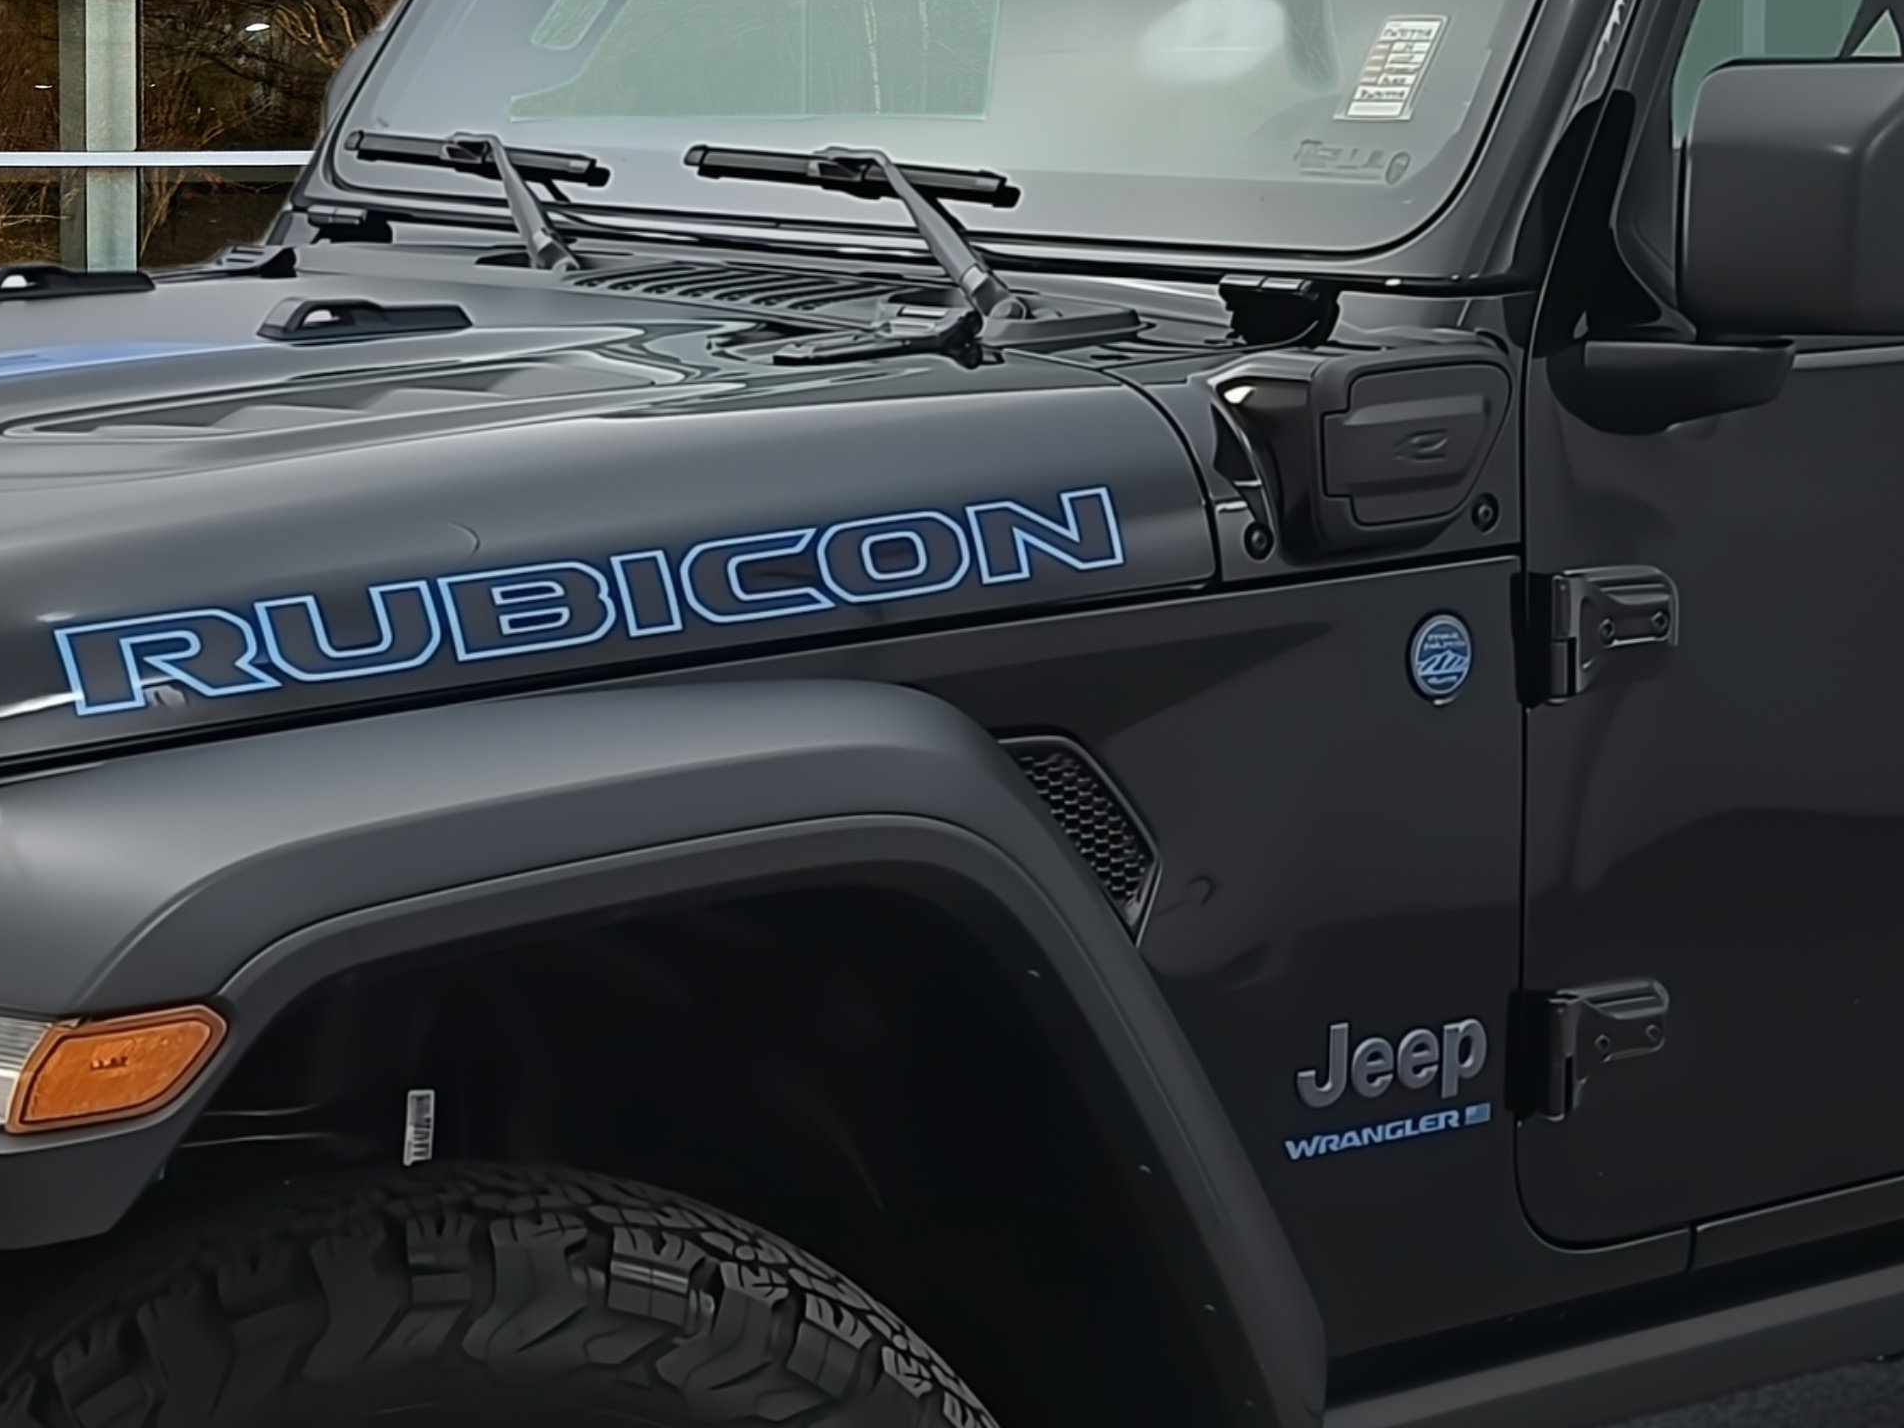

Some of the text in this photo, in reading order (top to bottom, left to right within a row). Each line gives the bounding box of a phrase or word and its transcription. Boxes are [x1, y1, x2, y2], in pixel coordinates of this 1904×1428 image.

[53, 485, 1126, 718] RUBICON
[1296, 1017, 1489, 1109] Jeep
[1284, 1109, 1461, 1161] WRANGLER
